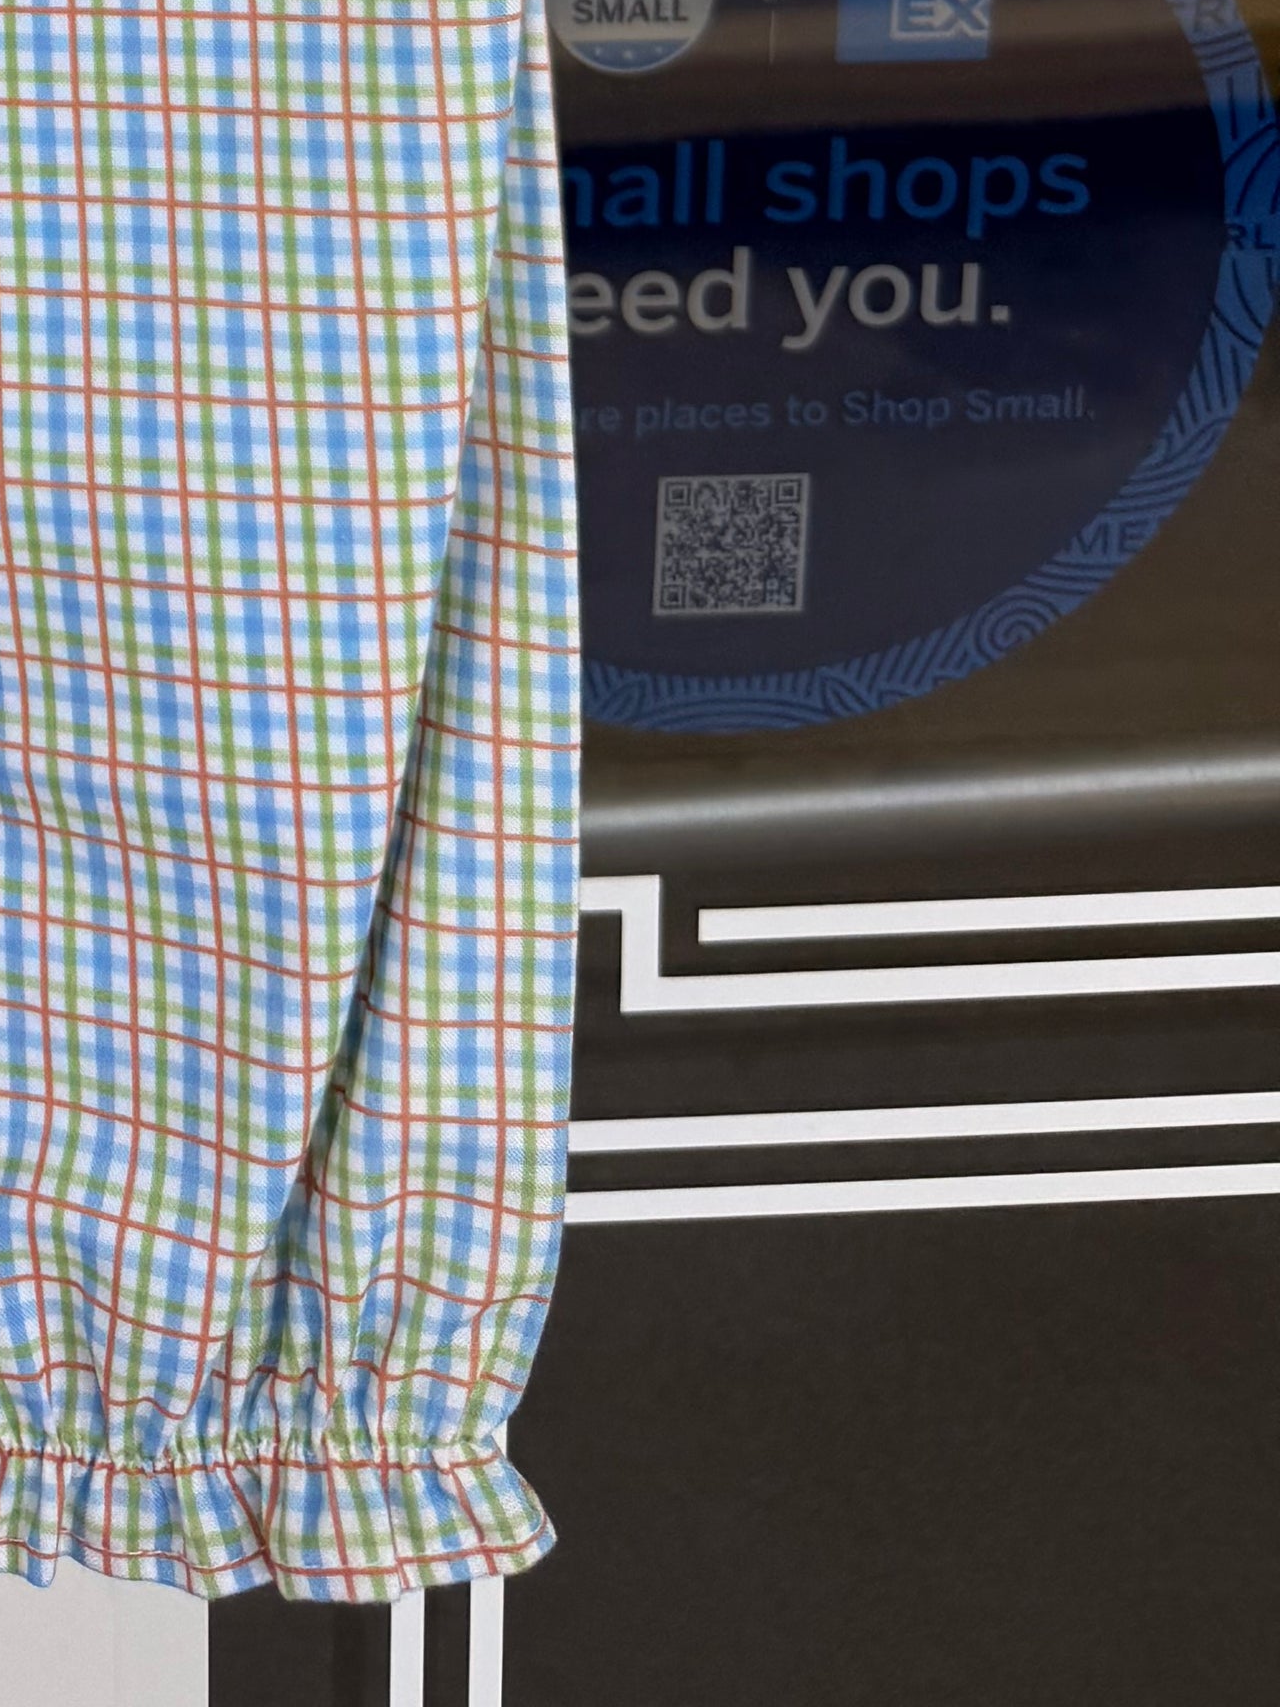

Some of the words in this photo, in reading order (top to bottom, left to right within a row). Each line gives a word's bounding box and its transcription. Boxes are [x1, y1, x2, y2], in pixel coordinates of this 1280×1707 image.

[763, 136, 1090, 240] shops
[567, 245, 751, 335] eed
[781, 261, 1010, 350] you.
[578, 404, 622, 432] re
[635, 397, 772, 437] places
[786, 394, 828, 427] to
[842, 389, 951, 430] Shop
[964, 384, 1096, 423] Small.
